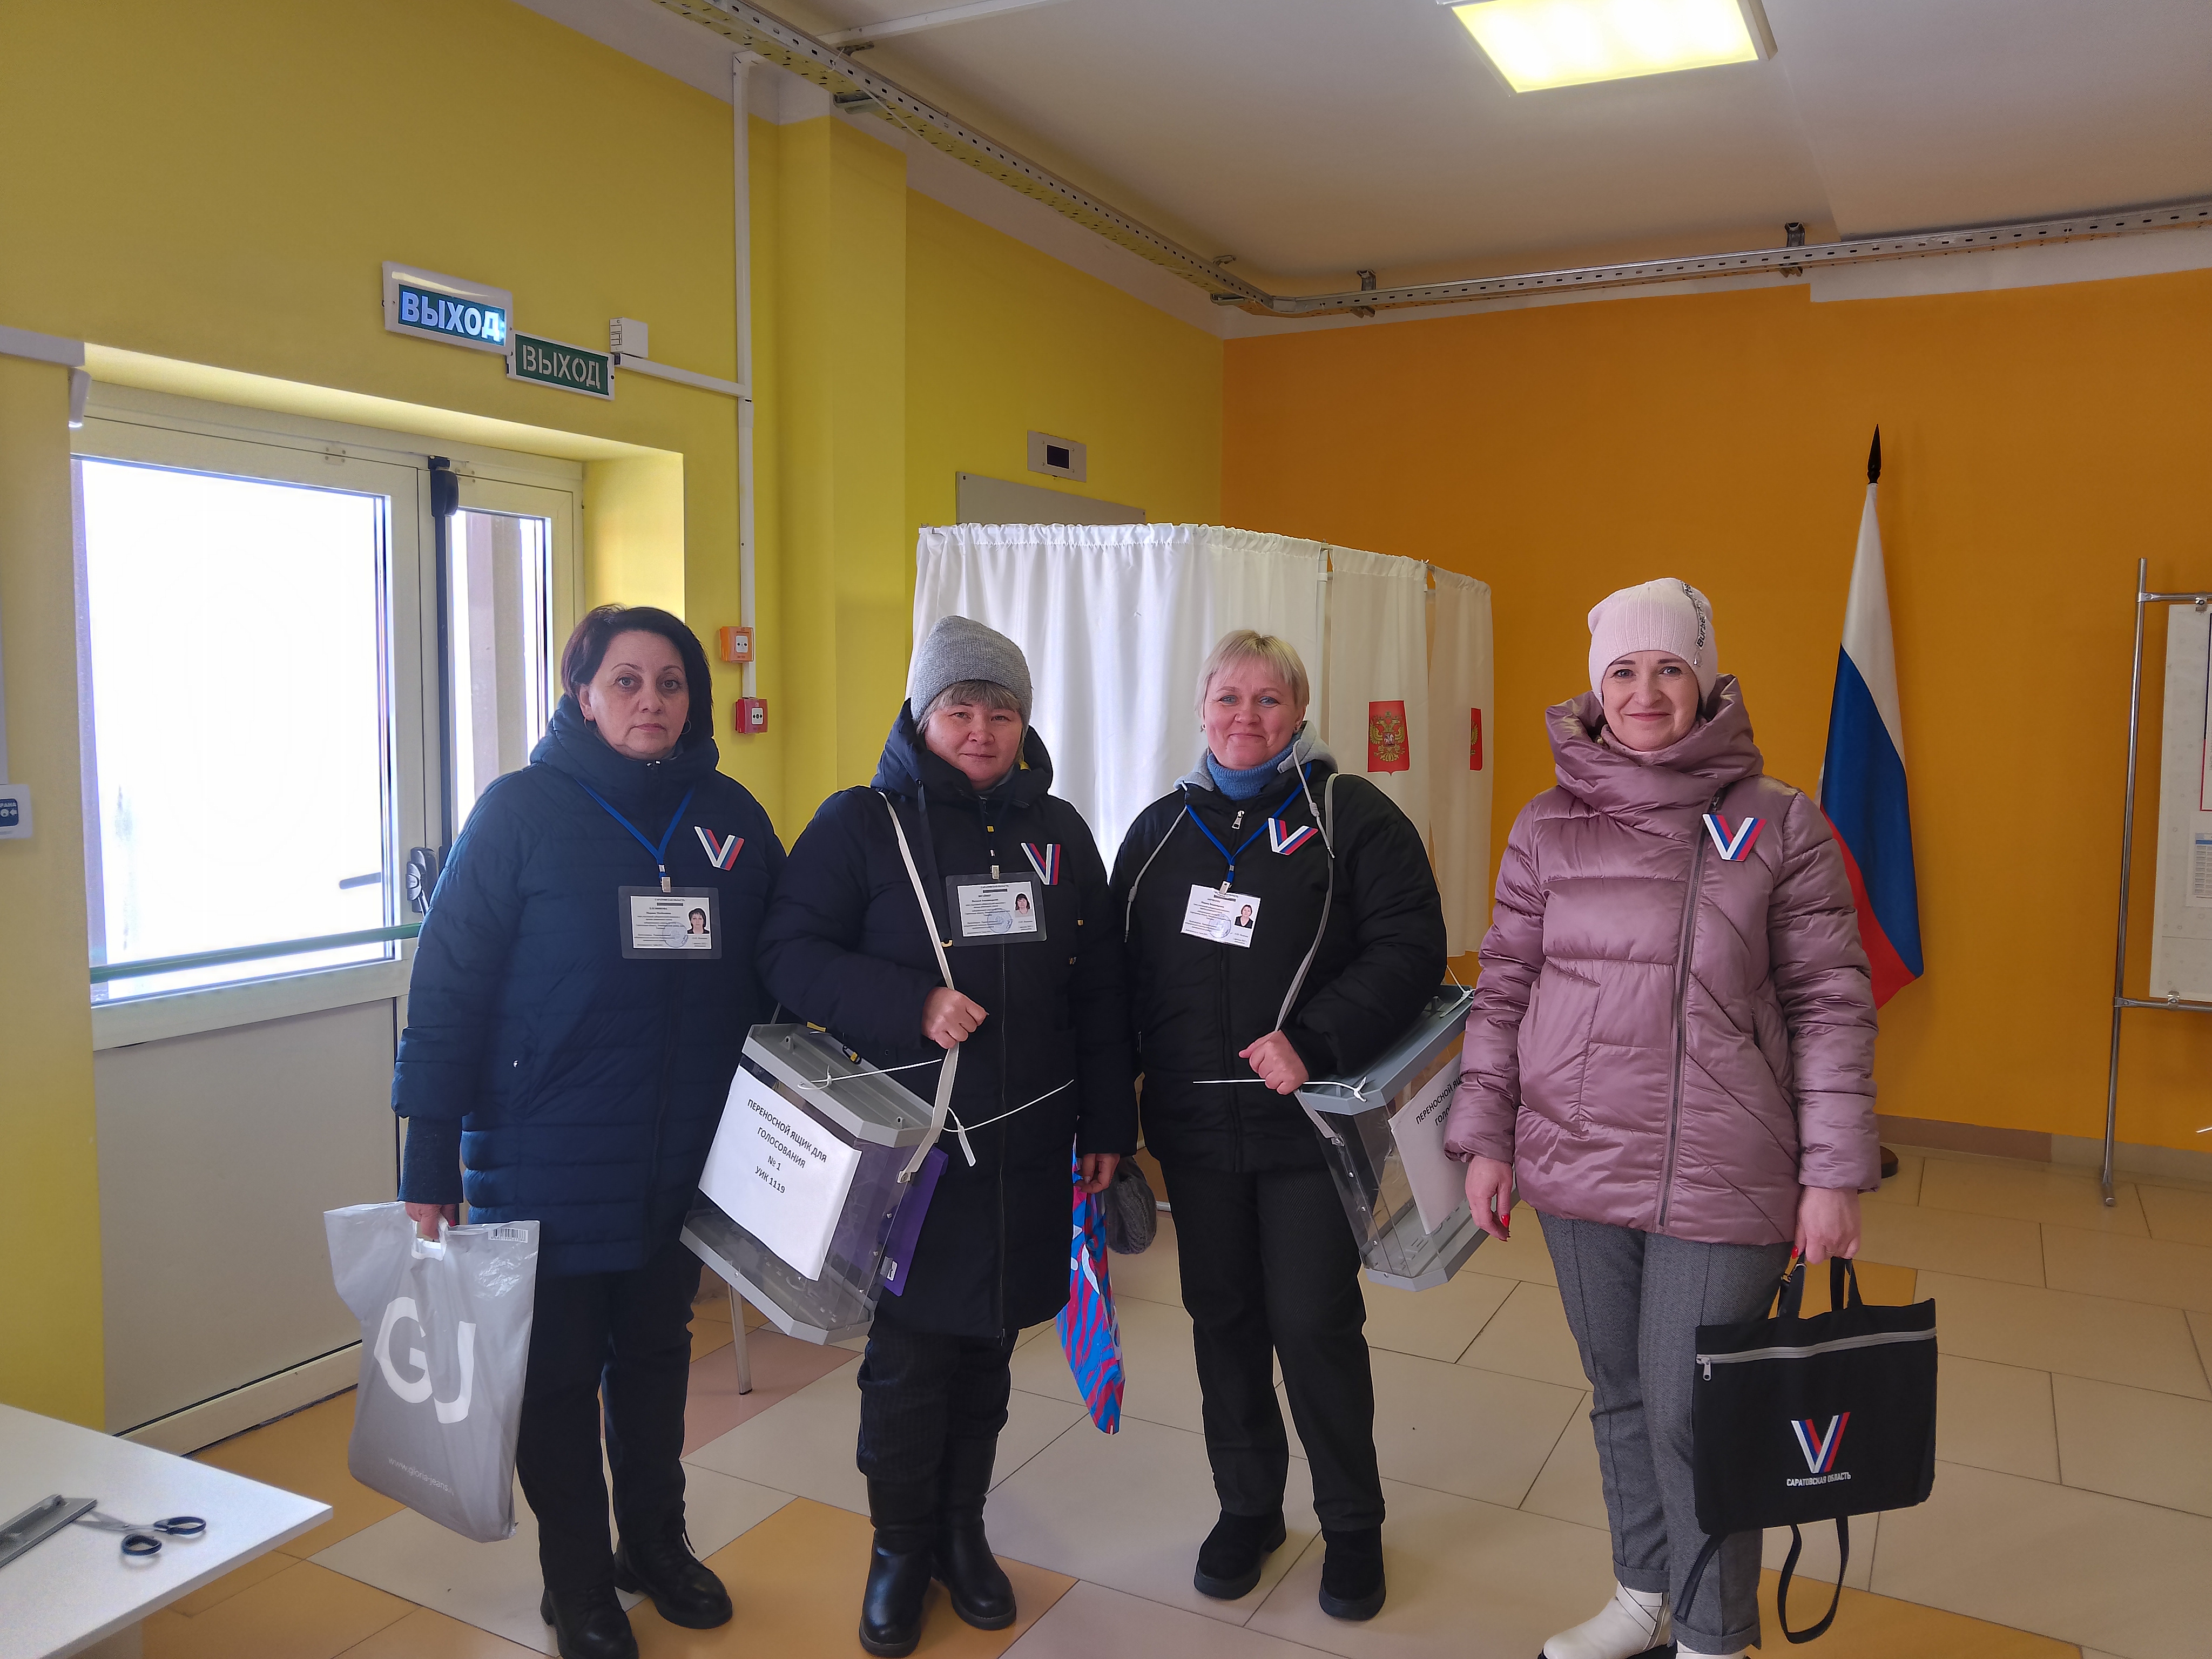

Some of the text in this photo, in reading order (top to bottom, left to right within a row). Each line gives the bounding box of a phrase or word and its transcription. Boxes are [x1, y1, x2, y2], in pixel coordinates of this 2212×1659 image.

[402, 291, 501, 342] ВЫХОД
[523, 345, 601, 389] ВЫХОД
[1415, 1076, 1462, 1125] ПЕРЕНОСНОЙ ЯЩ
[747, 1098, 827, 1163] ПЕРЕНОСНОЙ ЯЩИК ДЛЯ
[757, 1127, 806, 1168] ГОЛОСОВАНИЯ
[755, 1166, 785, 1193] УИК 1119
[767, 1156, 781, 1171] № 1
[1786, 1472, 1851, 1486] САРАТОВСКАЯ ОБЛАСТЬ
